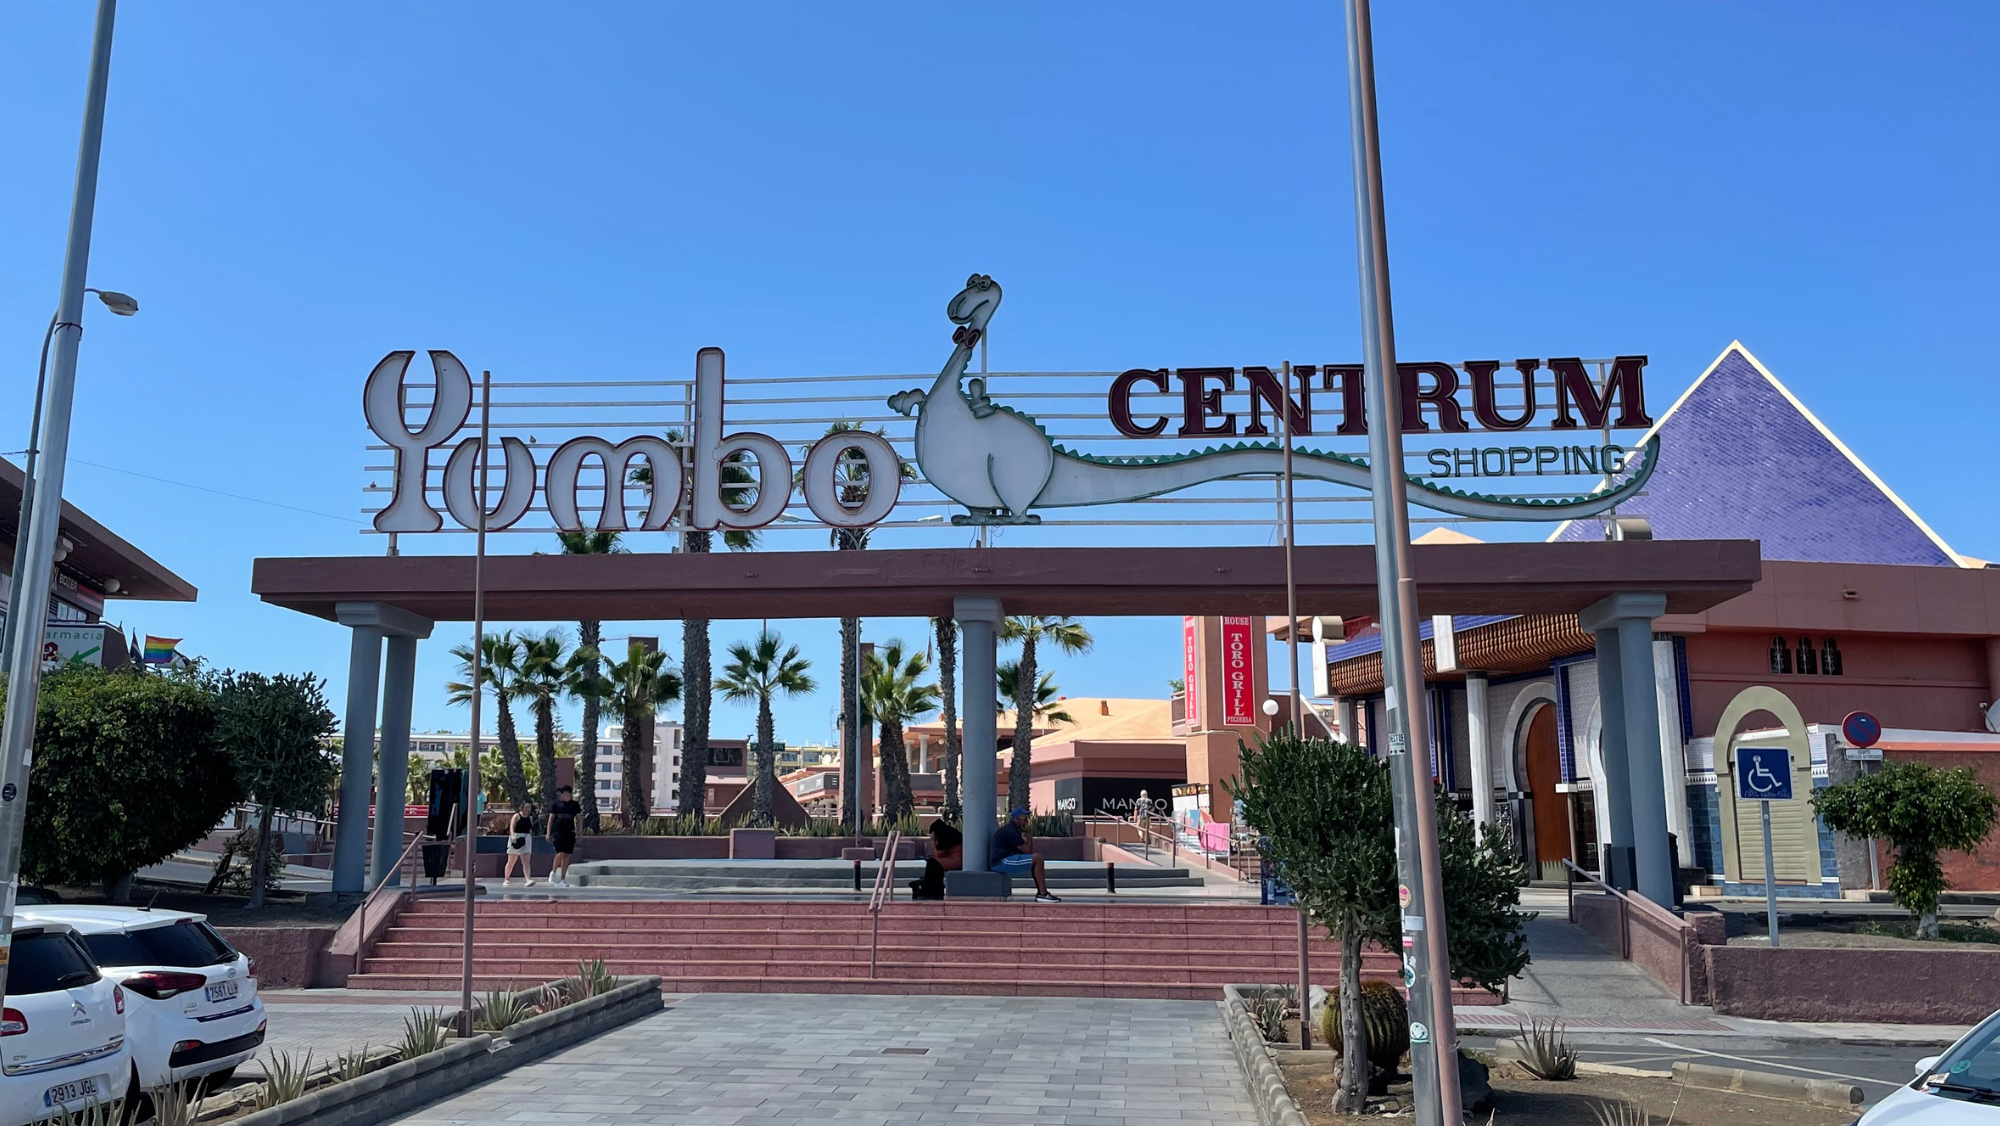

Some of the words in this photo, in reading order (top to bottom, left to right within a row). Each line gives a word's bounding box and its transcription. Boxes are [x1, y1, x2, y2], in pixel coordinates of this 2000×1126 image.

[1108, 355, 1654, 438] CENTRUM
[363, 347, 900, 532] Yumbo
[1427, 443, 1626, 478] SHOPPING
[45, 631, 103, 640] armacia
[1224, 616, 1249, 626] HOUSE
[1230, 633, 1244, 669] TORO
[1231, 671, 1245, 716] GRILL
[1102, 797, 1168, 810] MANO
[51, 1083, 77, 1104] 2913
[79, 1079, 97, 1096] JGL
